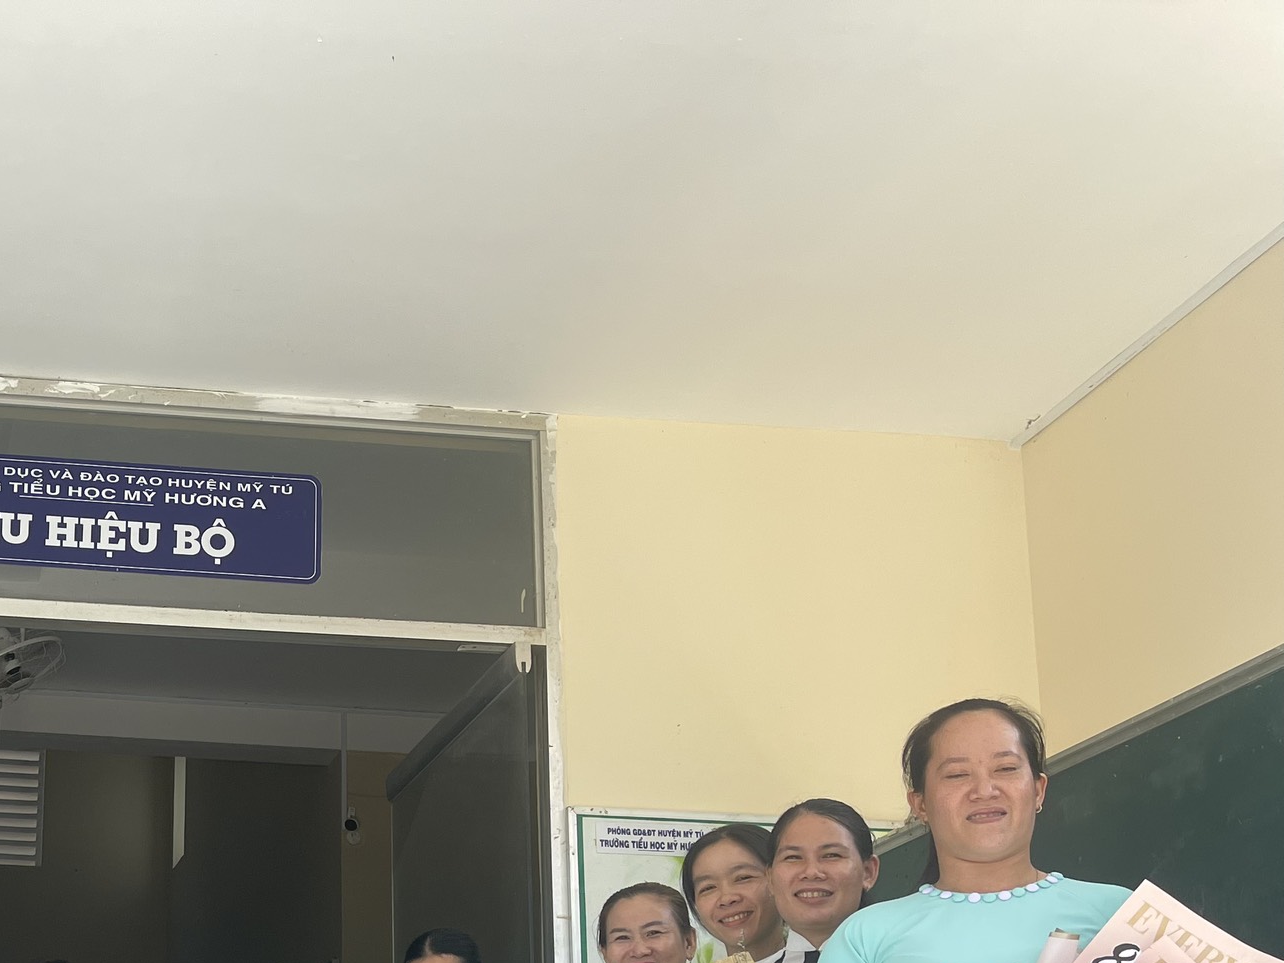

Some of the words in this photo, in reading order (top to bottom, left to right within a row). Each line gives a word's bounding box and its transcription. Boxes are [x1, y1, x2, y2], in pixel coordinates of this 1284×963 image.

[4, 466, 43, 478] DỤC
[49, 468, 73, 480] VÀ
[79, 471, 120, 483] ĐÀO
[125, 475, 163, 487] TẠO
[168, 478, 231, 492] HUYỆN
[237, 482, 264, 493] MỸ
[269, 484, 293, 495] TÚ
[9, 479, 60, 496] TIỂU
[68, 486, 116, 500] HỌC
[123, 488, 157, 502] MỸ
[165, 492, 245, 509] HƯƠNG
[251, 498, 267, 510] A
[45, 511, 161, 558] HIỆU
[173, 518, 235, 565] BỘ
[600, 838, 630, 849] TRƯỜNG
[631, 837, 648, 849] TIỂU
[650, 841, 665, 851] HỌC
[658, 829, 682, 839] HUYỆN
[683, 829, 694, 838] MỸ
